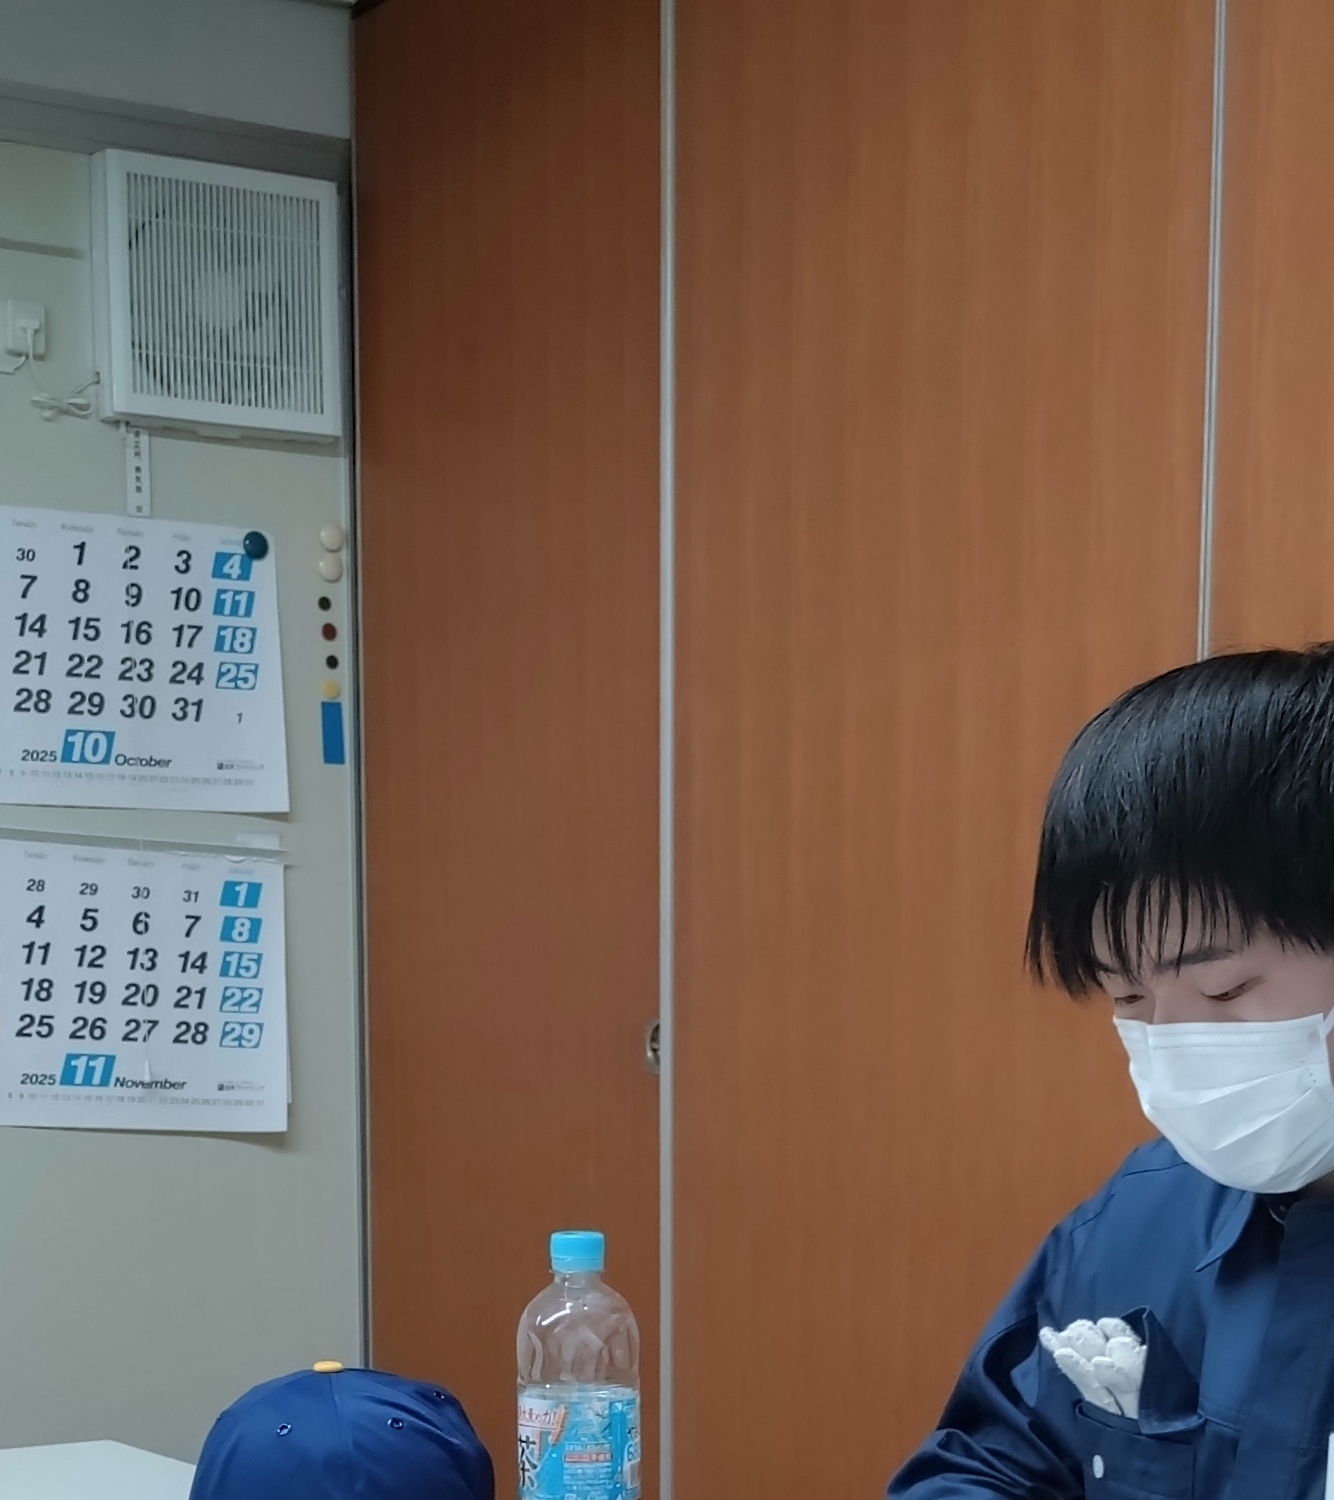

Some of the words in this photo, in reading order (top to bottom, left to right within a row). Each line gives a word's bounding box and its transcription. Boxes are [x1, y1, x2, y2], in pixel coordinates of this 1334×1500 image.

[16, 547, 36, 562] 30
[72, 541, 87, 566] 1
[122, 544, 141, 571] 2
[174, 549, 192, 574] 3
[222, 555, 242, 579] 4
[19, 574, 38, 599] 7
[71, 579, 91, 603] 8
[125, 583, 142, 607] 9
[170, 587, 202, 612] 10
[219, 592, 249, 616] 11
[14, 613, 48, 638] 14
[67, 617, 101, 642] 15
[120, 621, 152, 645] 16
[172, 624, 203, 648] 17
[219, 627, 252, 653] 18
[13, 650, 48, 676] 21
[66, 654, 104, 679] 22
[118, 658, 154, 682] 23
[169, 661, 205, 686] 24
[218, 664, 257, 689] 25
[14, 689, 52, 714] 28
[67, 692, 105, 717] 29
[120, 695, 157, 720] 30
[172, 698, 204, 723] 31
[236, 713, 243, 725] 1
[21, 749, 57, 764] 2025
[69, 732, 106, 762] 10
[115, 754, 172, 769] October
[26, 878, 45, 892] 28
[79, 882, 99, 896] 29
[132, 886, 150, 900] 30
[183, 890, 199, 903] 31
[234, 883, 248, 906] 1
[26, 905, 46, 928] 4
[80, 908, 100, 932] 5
[132, 911, 150, 935] 6
[184, 915, 201, 938] 7
[232, 918, 251, 942] 8
[22, 941, 51, 966] 11
[74, 944, 107, 969] 12
[126, 948, 158, 972] 13
[178, 951, 208, 975] 14
[225, 954, 258, 978] 15
[21, 978, 54, 1002] 18
[74, 981, 107, 1005] 19
[122, 983, 159, 1008] 20
[173, 986, 208, 1009] 21
[222, 988, 260, 1012] 22
[16, 1014, 55, 1039] 25
[69, 1017, 107, 1041] 26
[122, 1019, 159, 1043] 27
[173, 1022, 209, 1045] 28
[221, 1023, 261, 1048] 29
[20, 1073, 57, 1086] 2025
[69, 1056, 107, 1086] 11
[114, 1076, 187, 1091] November
